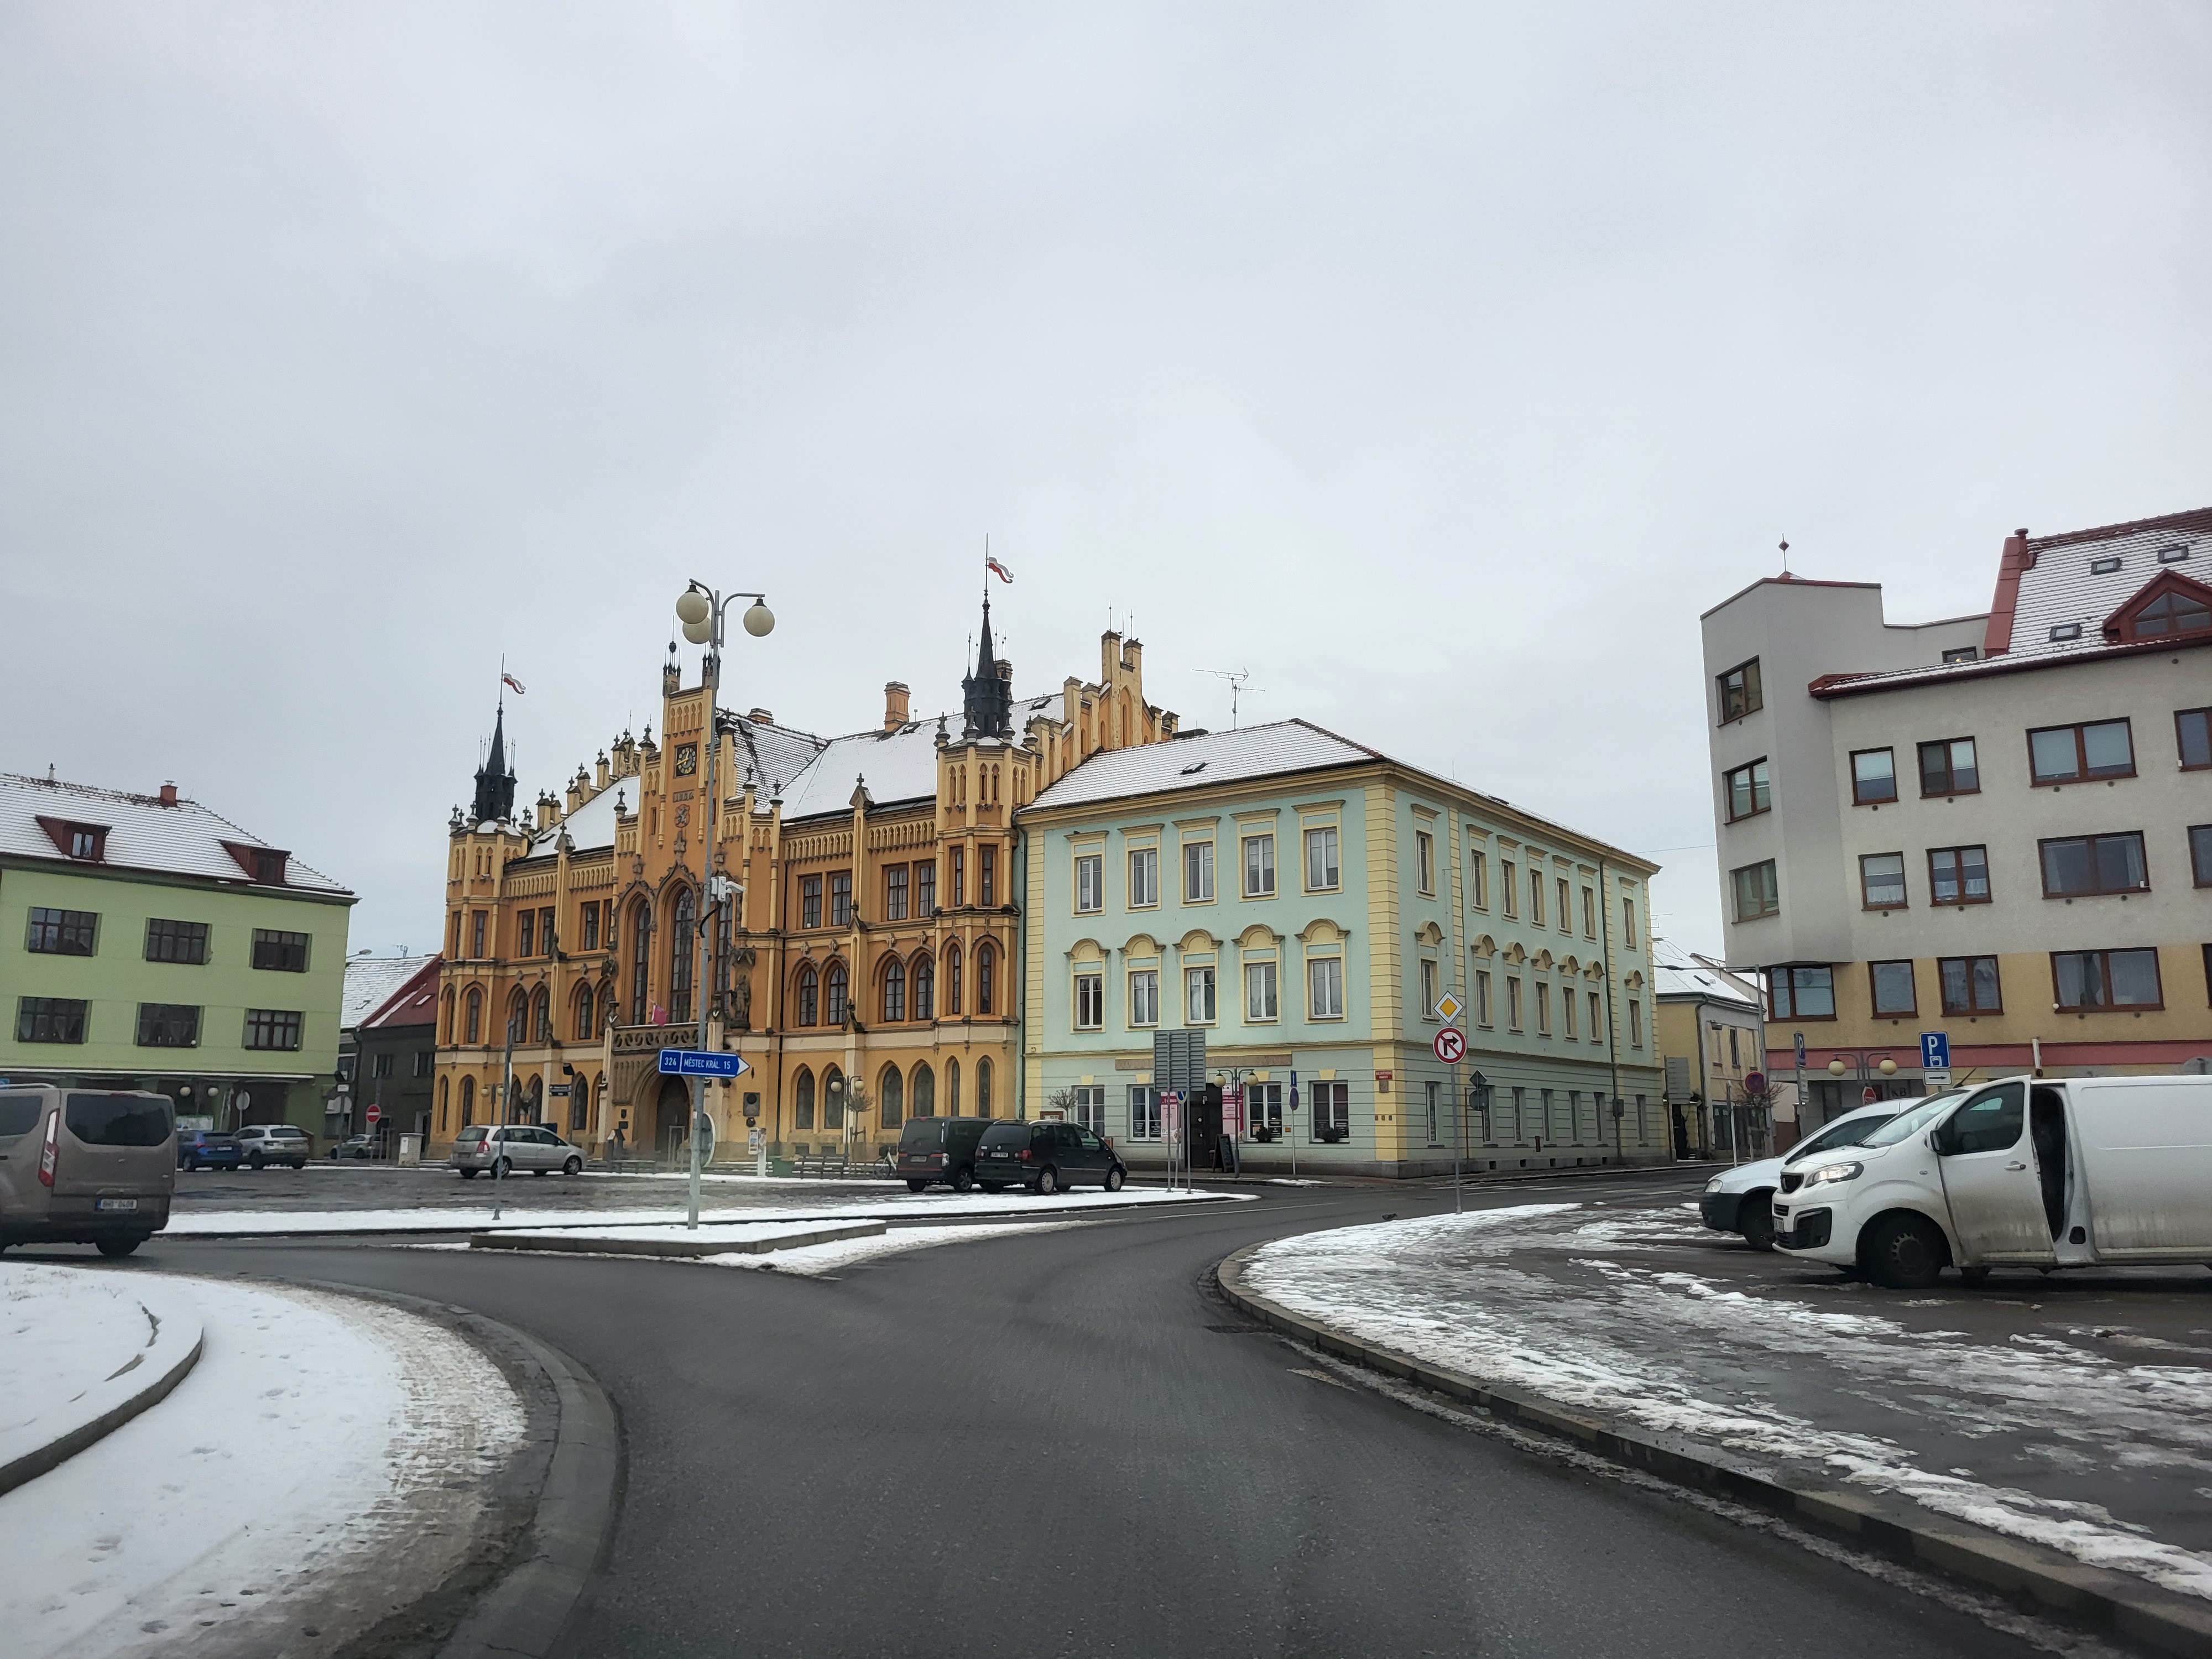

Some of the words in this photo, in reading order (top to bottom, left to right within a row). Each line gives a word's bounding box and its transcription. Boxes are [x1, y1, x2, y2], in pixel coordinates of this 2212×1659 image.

[1798, 1036, 1803, 1056] P
[1927, 1036, 1938, 1055] P
[664, 1057, 676, 1066] 324
[684, 1057, 705, 1068] MĚSTEC
[723, 1061, 731, 1070] 15
